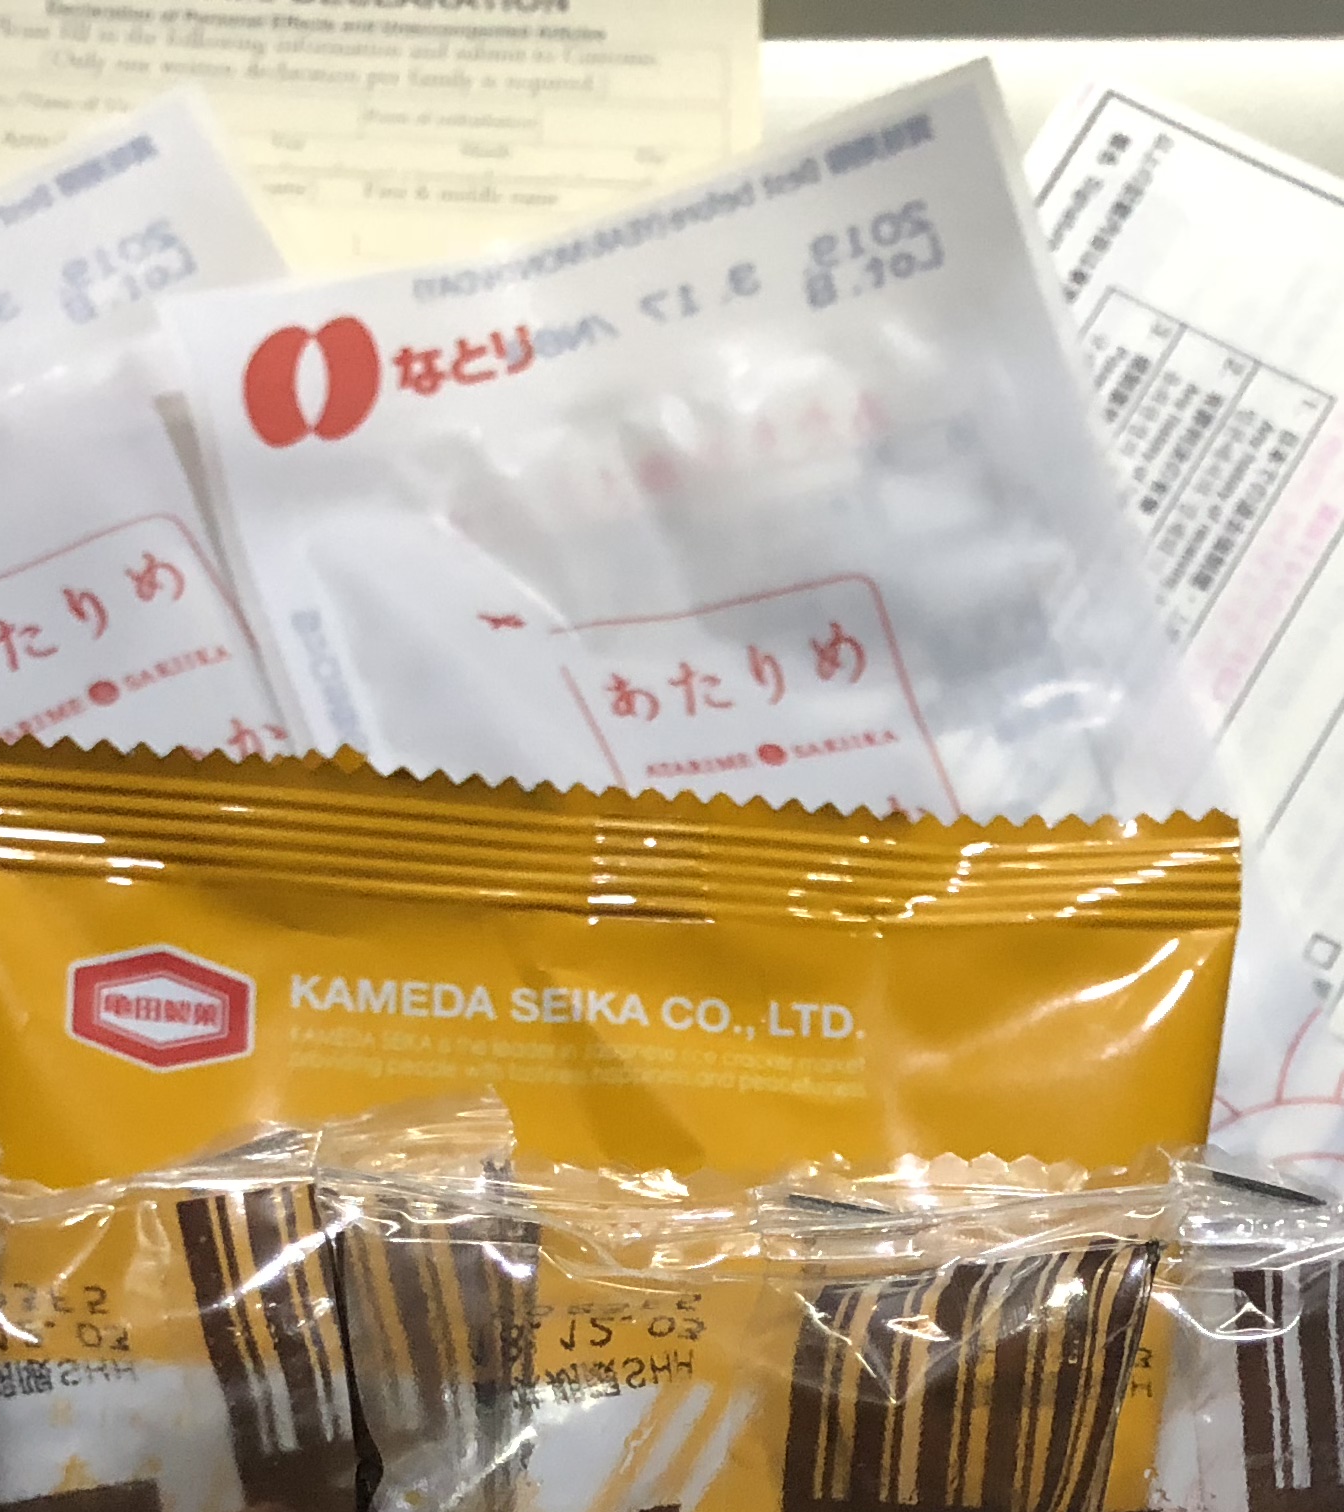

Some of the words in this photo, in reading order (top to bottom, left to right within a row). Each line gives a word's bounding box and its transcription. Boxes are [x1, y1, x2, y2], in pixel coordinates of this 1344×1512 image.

[392, 325, 536, 397] なとり
[602, 620, 868, 721] あたりめ
[287, 974, 498, 1021] KAMEDA
[510, 987, 651, 1028] SEIKA
[659, 997, 757, 1041] CO.,
[767, 1001, 867, 1041] LTD.
